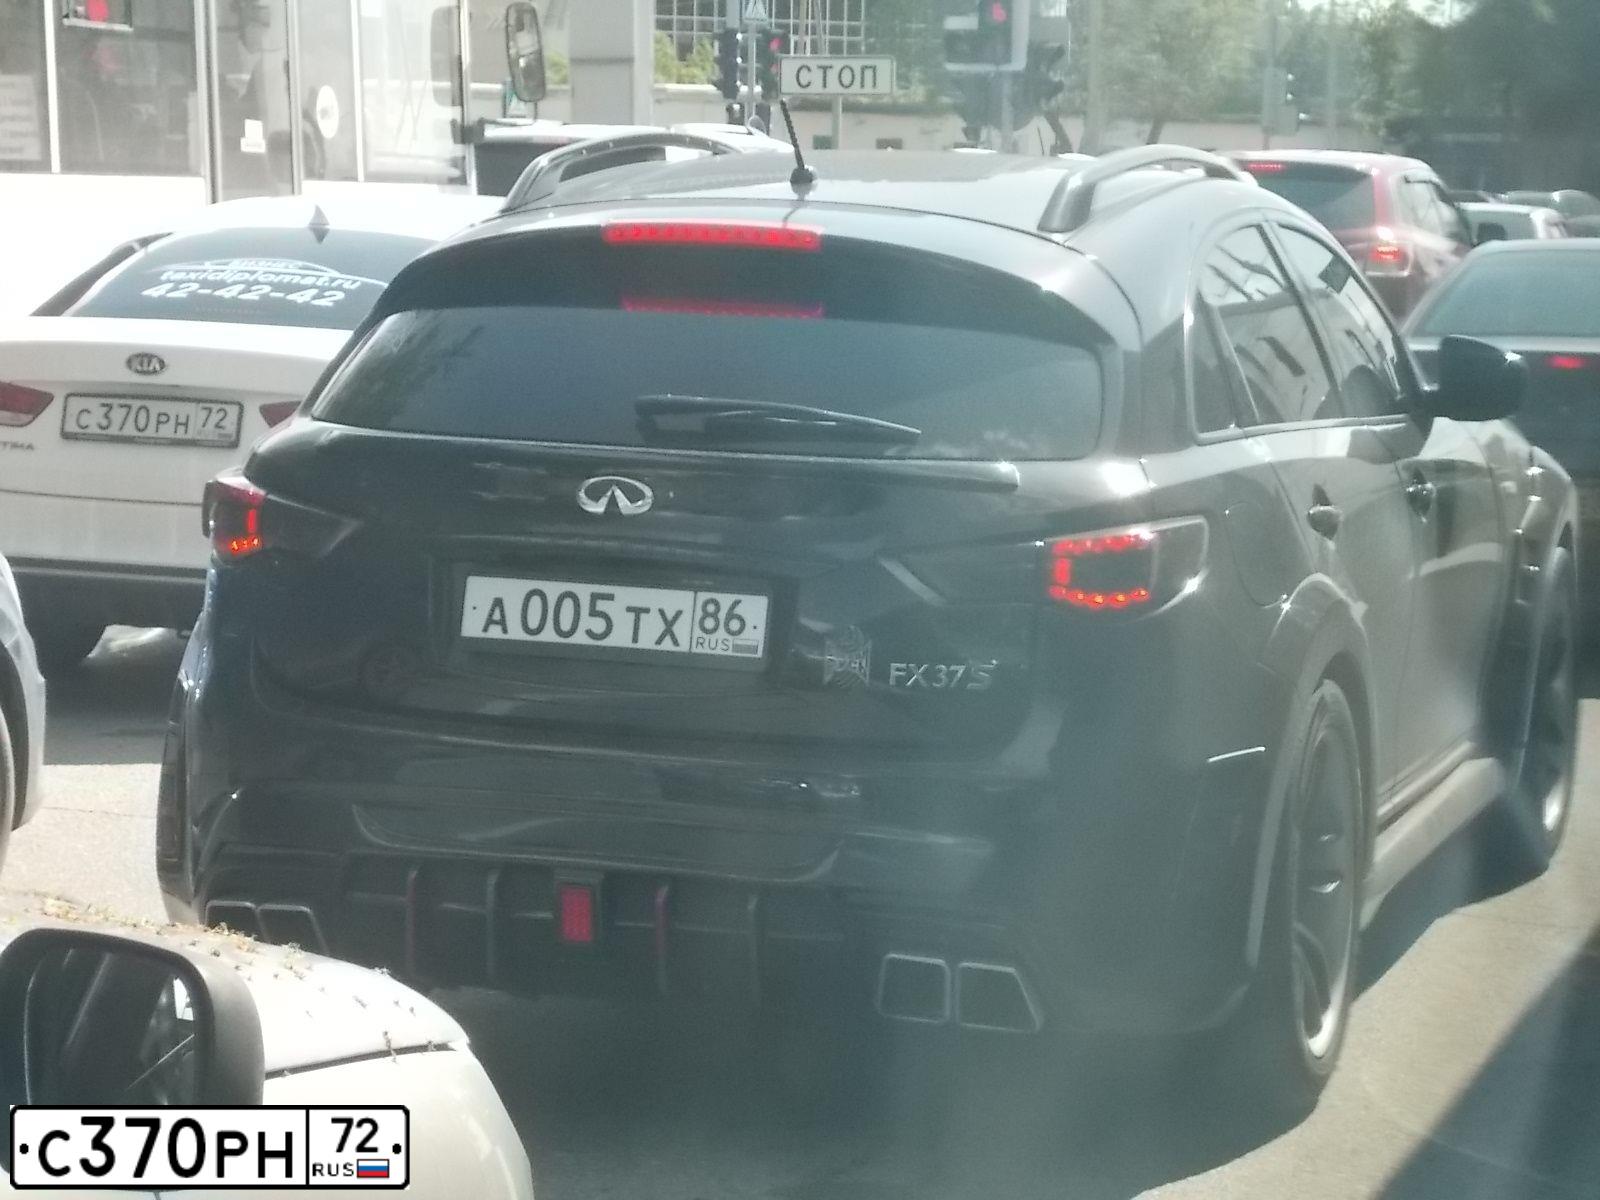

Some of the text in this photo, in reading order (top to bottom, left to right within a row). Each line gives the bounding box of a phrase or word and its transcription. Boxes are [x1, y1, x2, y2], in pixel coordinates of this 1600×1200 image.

[796, 64, 877, 88] СТОП
[141, 282, 346, 306] 42-42-42
[130, 356, 161, 371] KIA
[201, 406, 228, 430] 72
[699, 597, 746, 636] 86
[695, 636, 730, 652] RUS
